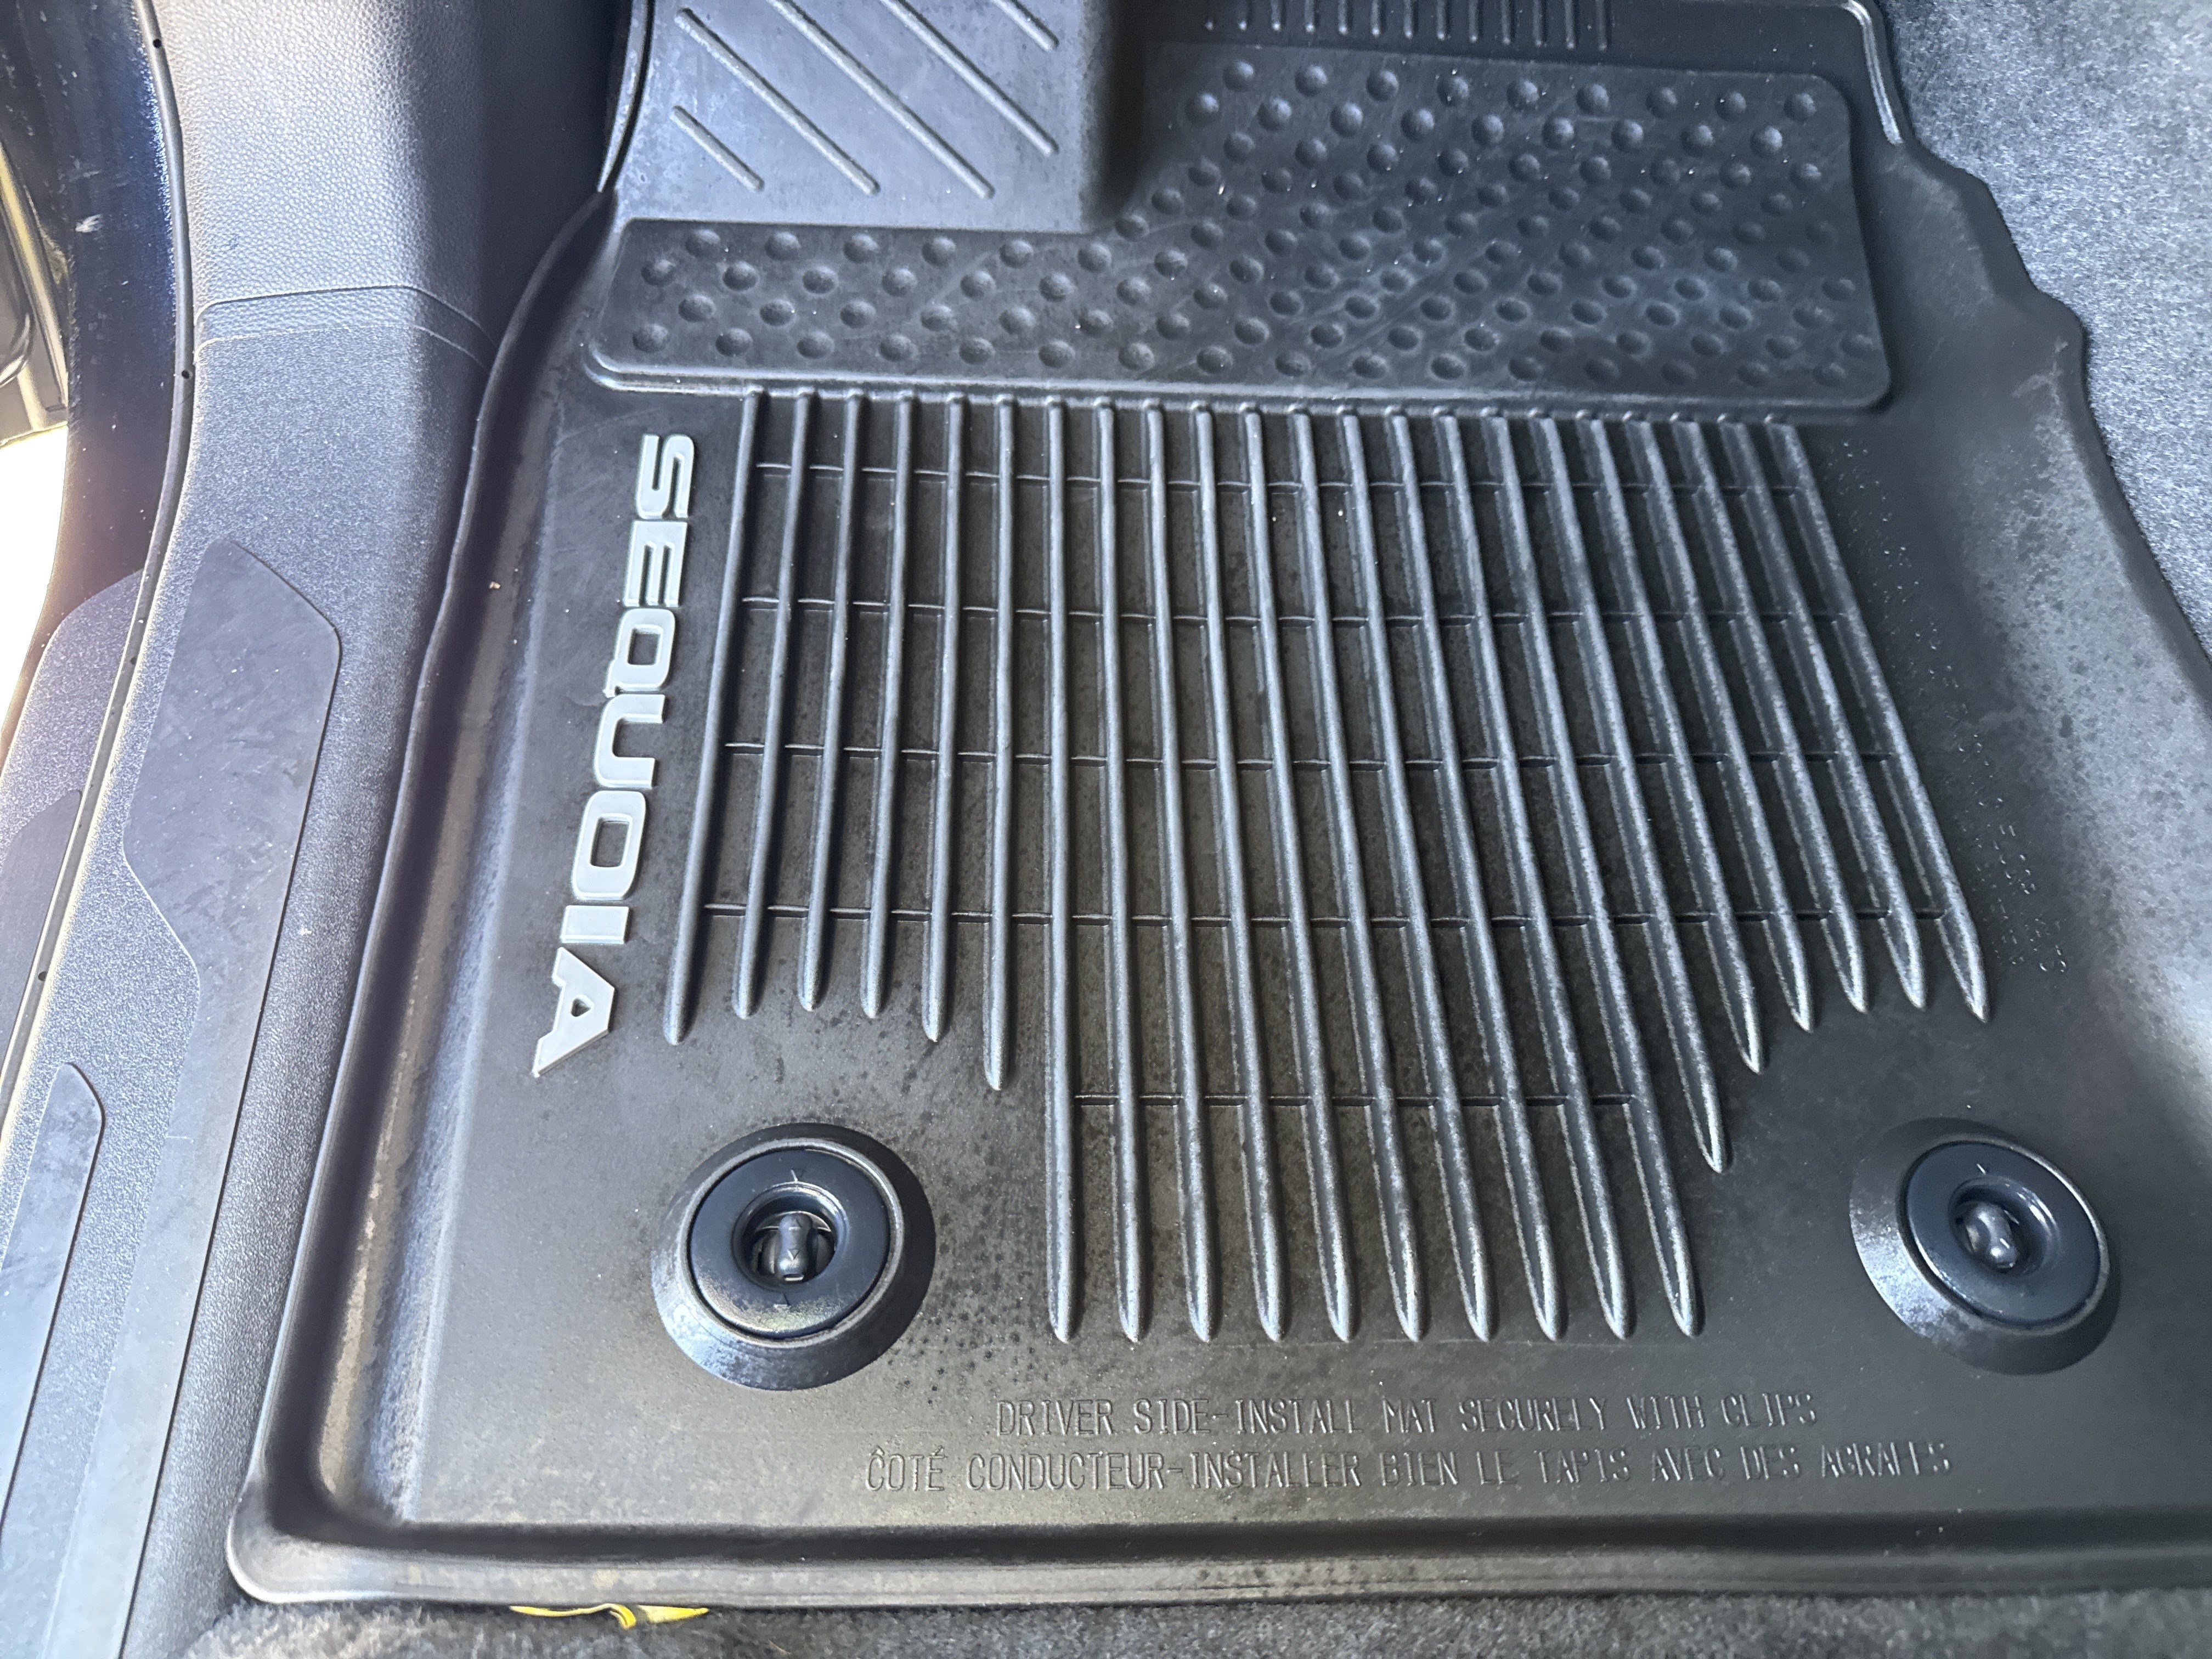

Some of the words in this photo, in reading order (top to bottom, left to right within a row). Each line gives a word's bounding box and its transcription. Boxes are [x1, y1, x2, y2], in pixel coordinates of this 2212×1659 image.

[532, 435, 695, 1077] SEQUOIA
[997, 1399, 1114, 1436] DRIVER
[1382, 1398, 1437, 1434] MAT
[1459, 1396, 1607, 1432] SECURELY
[1626, 1395, 1707, 1430] WITH
[1720, 1392, 1816, 1427] CLIPS
[1381, 1450, 1458, 1487] BIEN
[1476, 1449, 1519, 1485] LE
[1534, 1447, 1632, 1484] TAPIS
[1652, 1445, 1725, 1482] AVEC
[1740, 1444, 1801, 1481] DES
